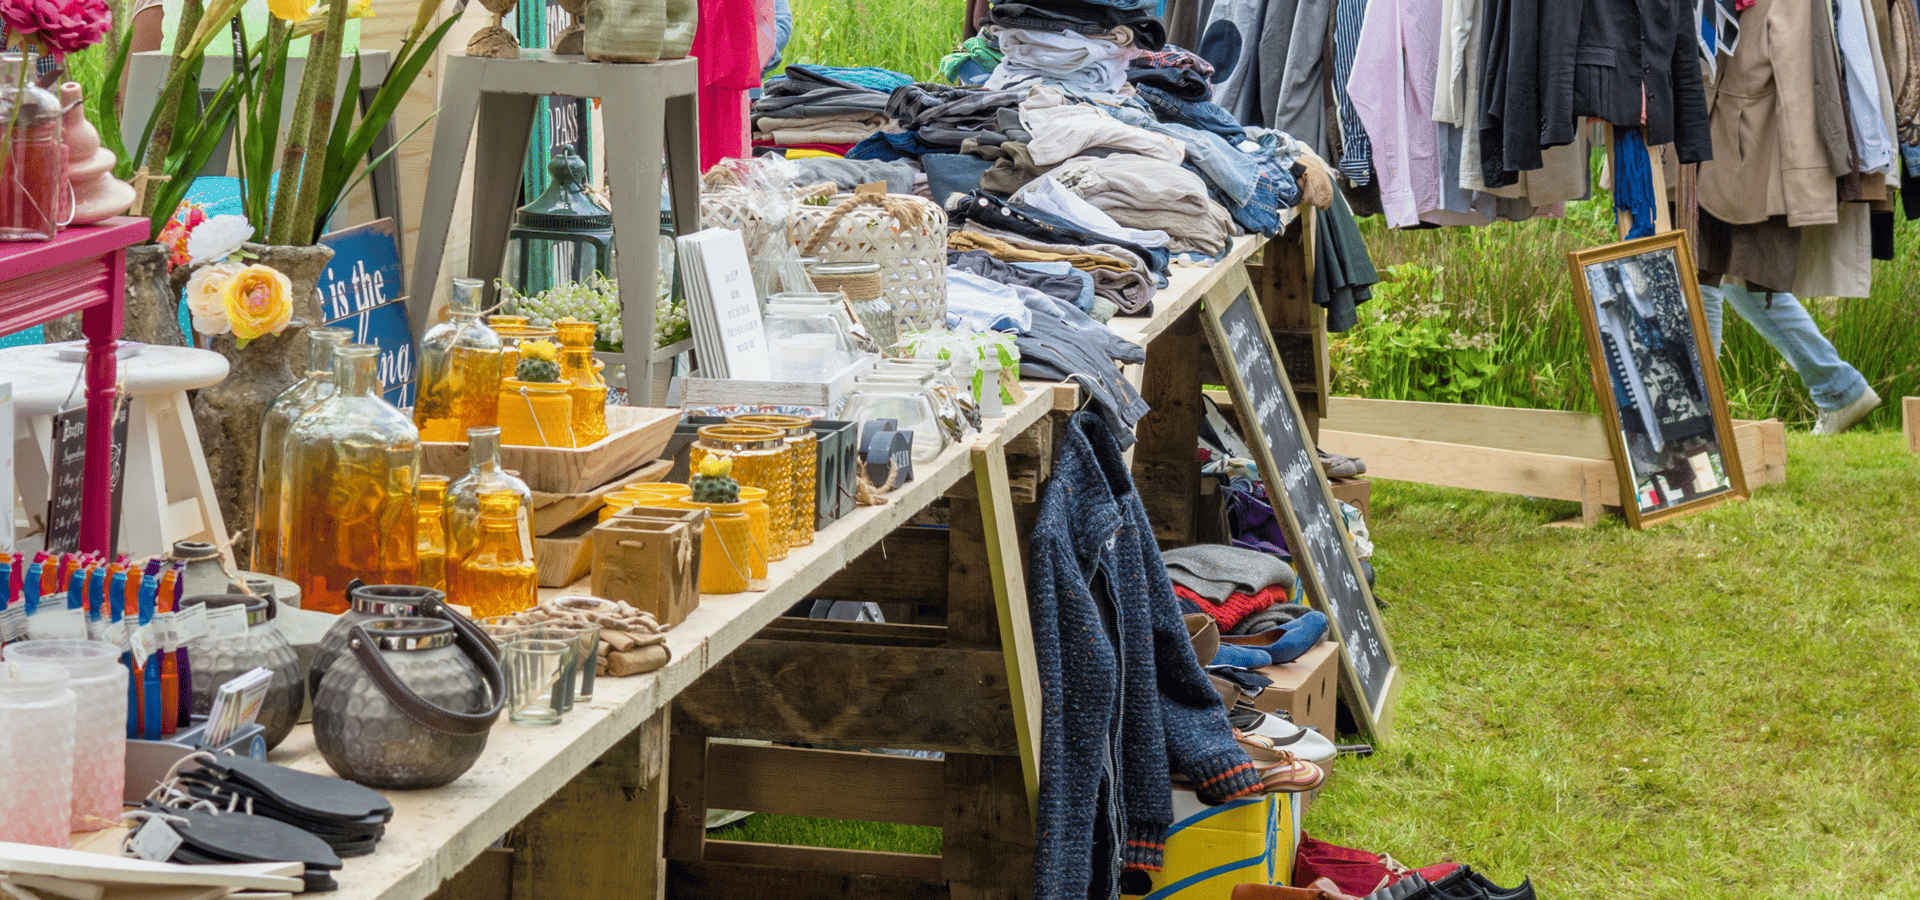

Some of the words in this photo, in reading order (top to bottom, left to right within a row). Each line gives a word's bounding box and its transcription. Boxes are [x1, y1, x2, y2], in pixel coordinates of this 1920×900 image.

[555, 103, 578, 147] PASS
[327, 267, 349, 319] is
[352, 260, 386, 311] the
